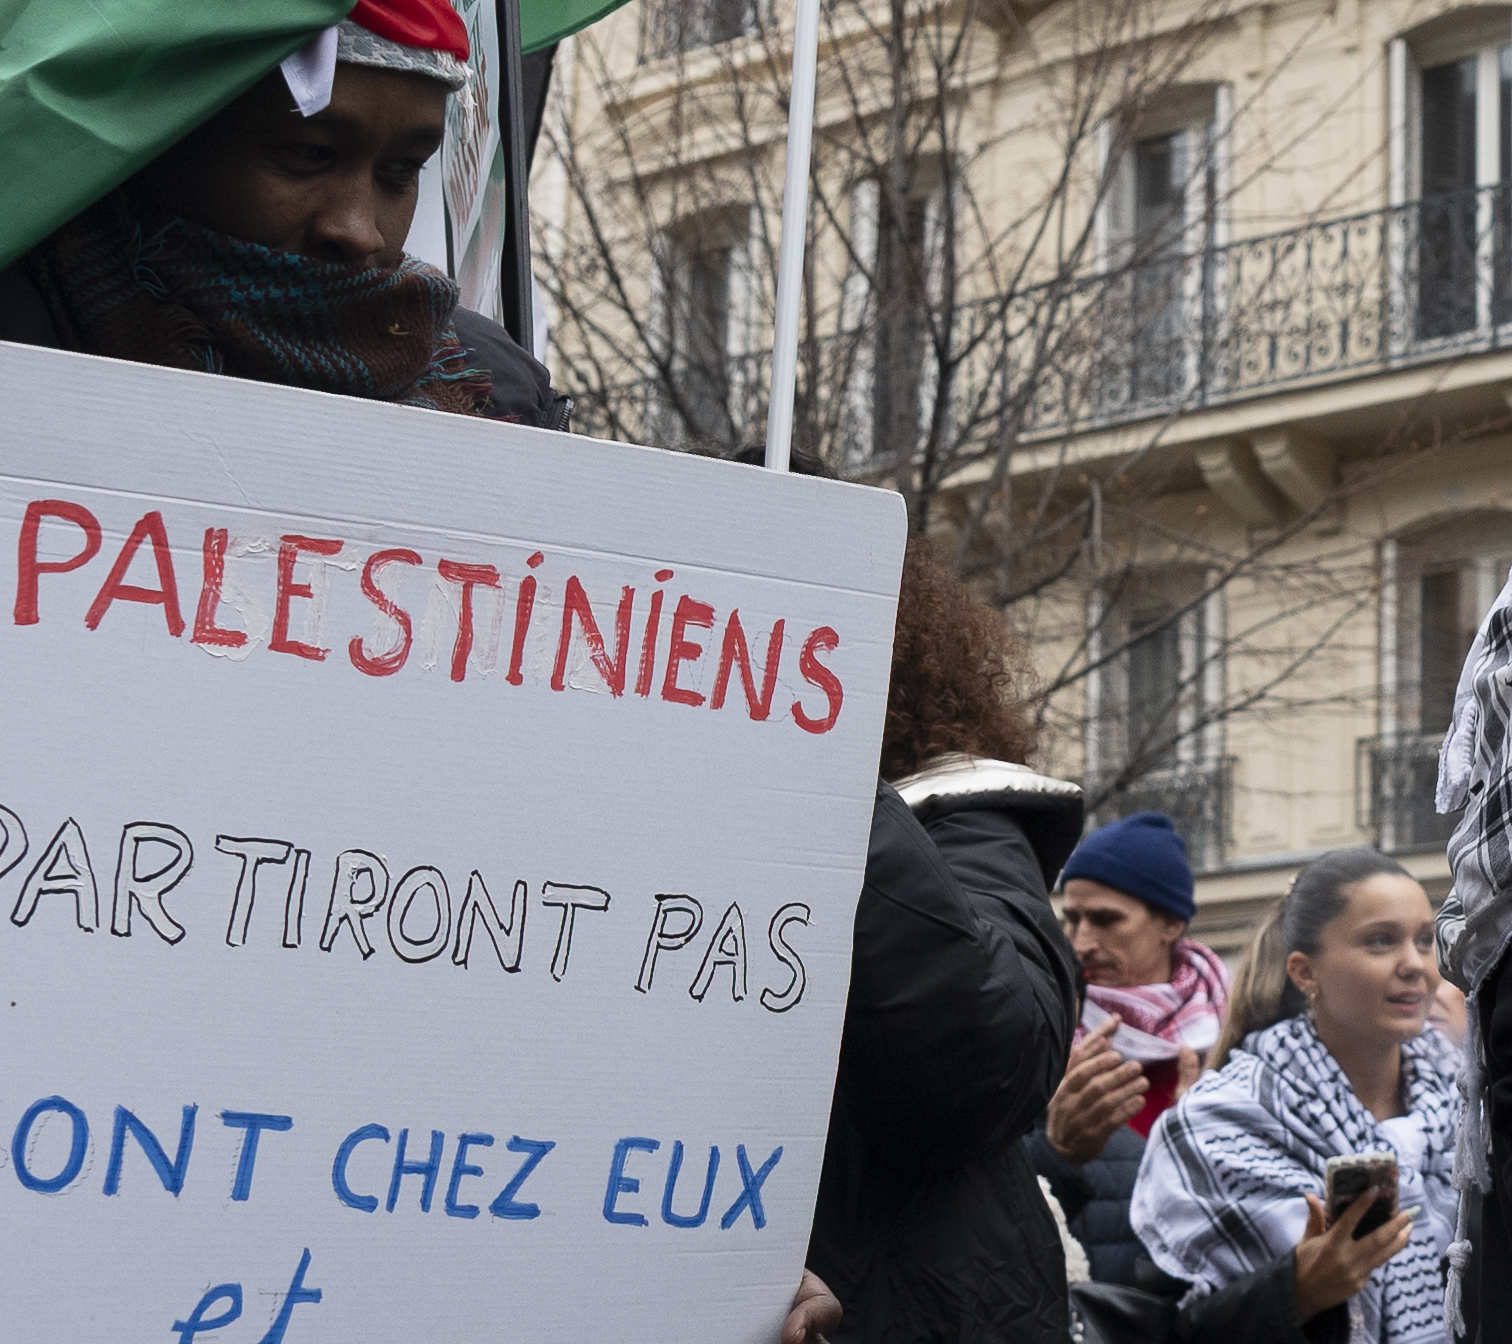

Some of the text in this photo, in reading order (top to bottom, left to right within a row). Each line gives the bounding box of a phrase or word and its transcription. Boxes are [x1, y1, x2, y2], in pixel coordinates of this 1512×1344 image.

[632, 892, 812, 1014] PAS
[331, 1122, 557, 1221] CHEZ
[601, 1136, 784, 1231] EUX
